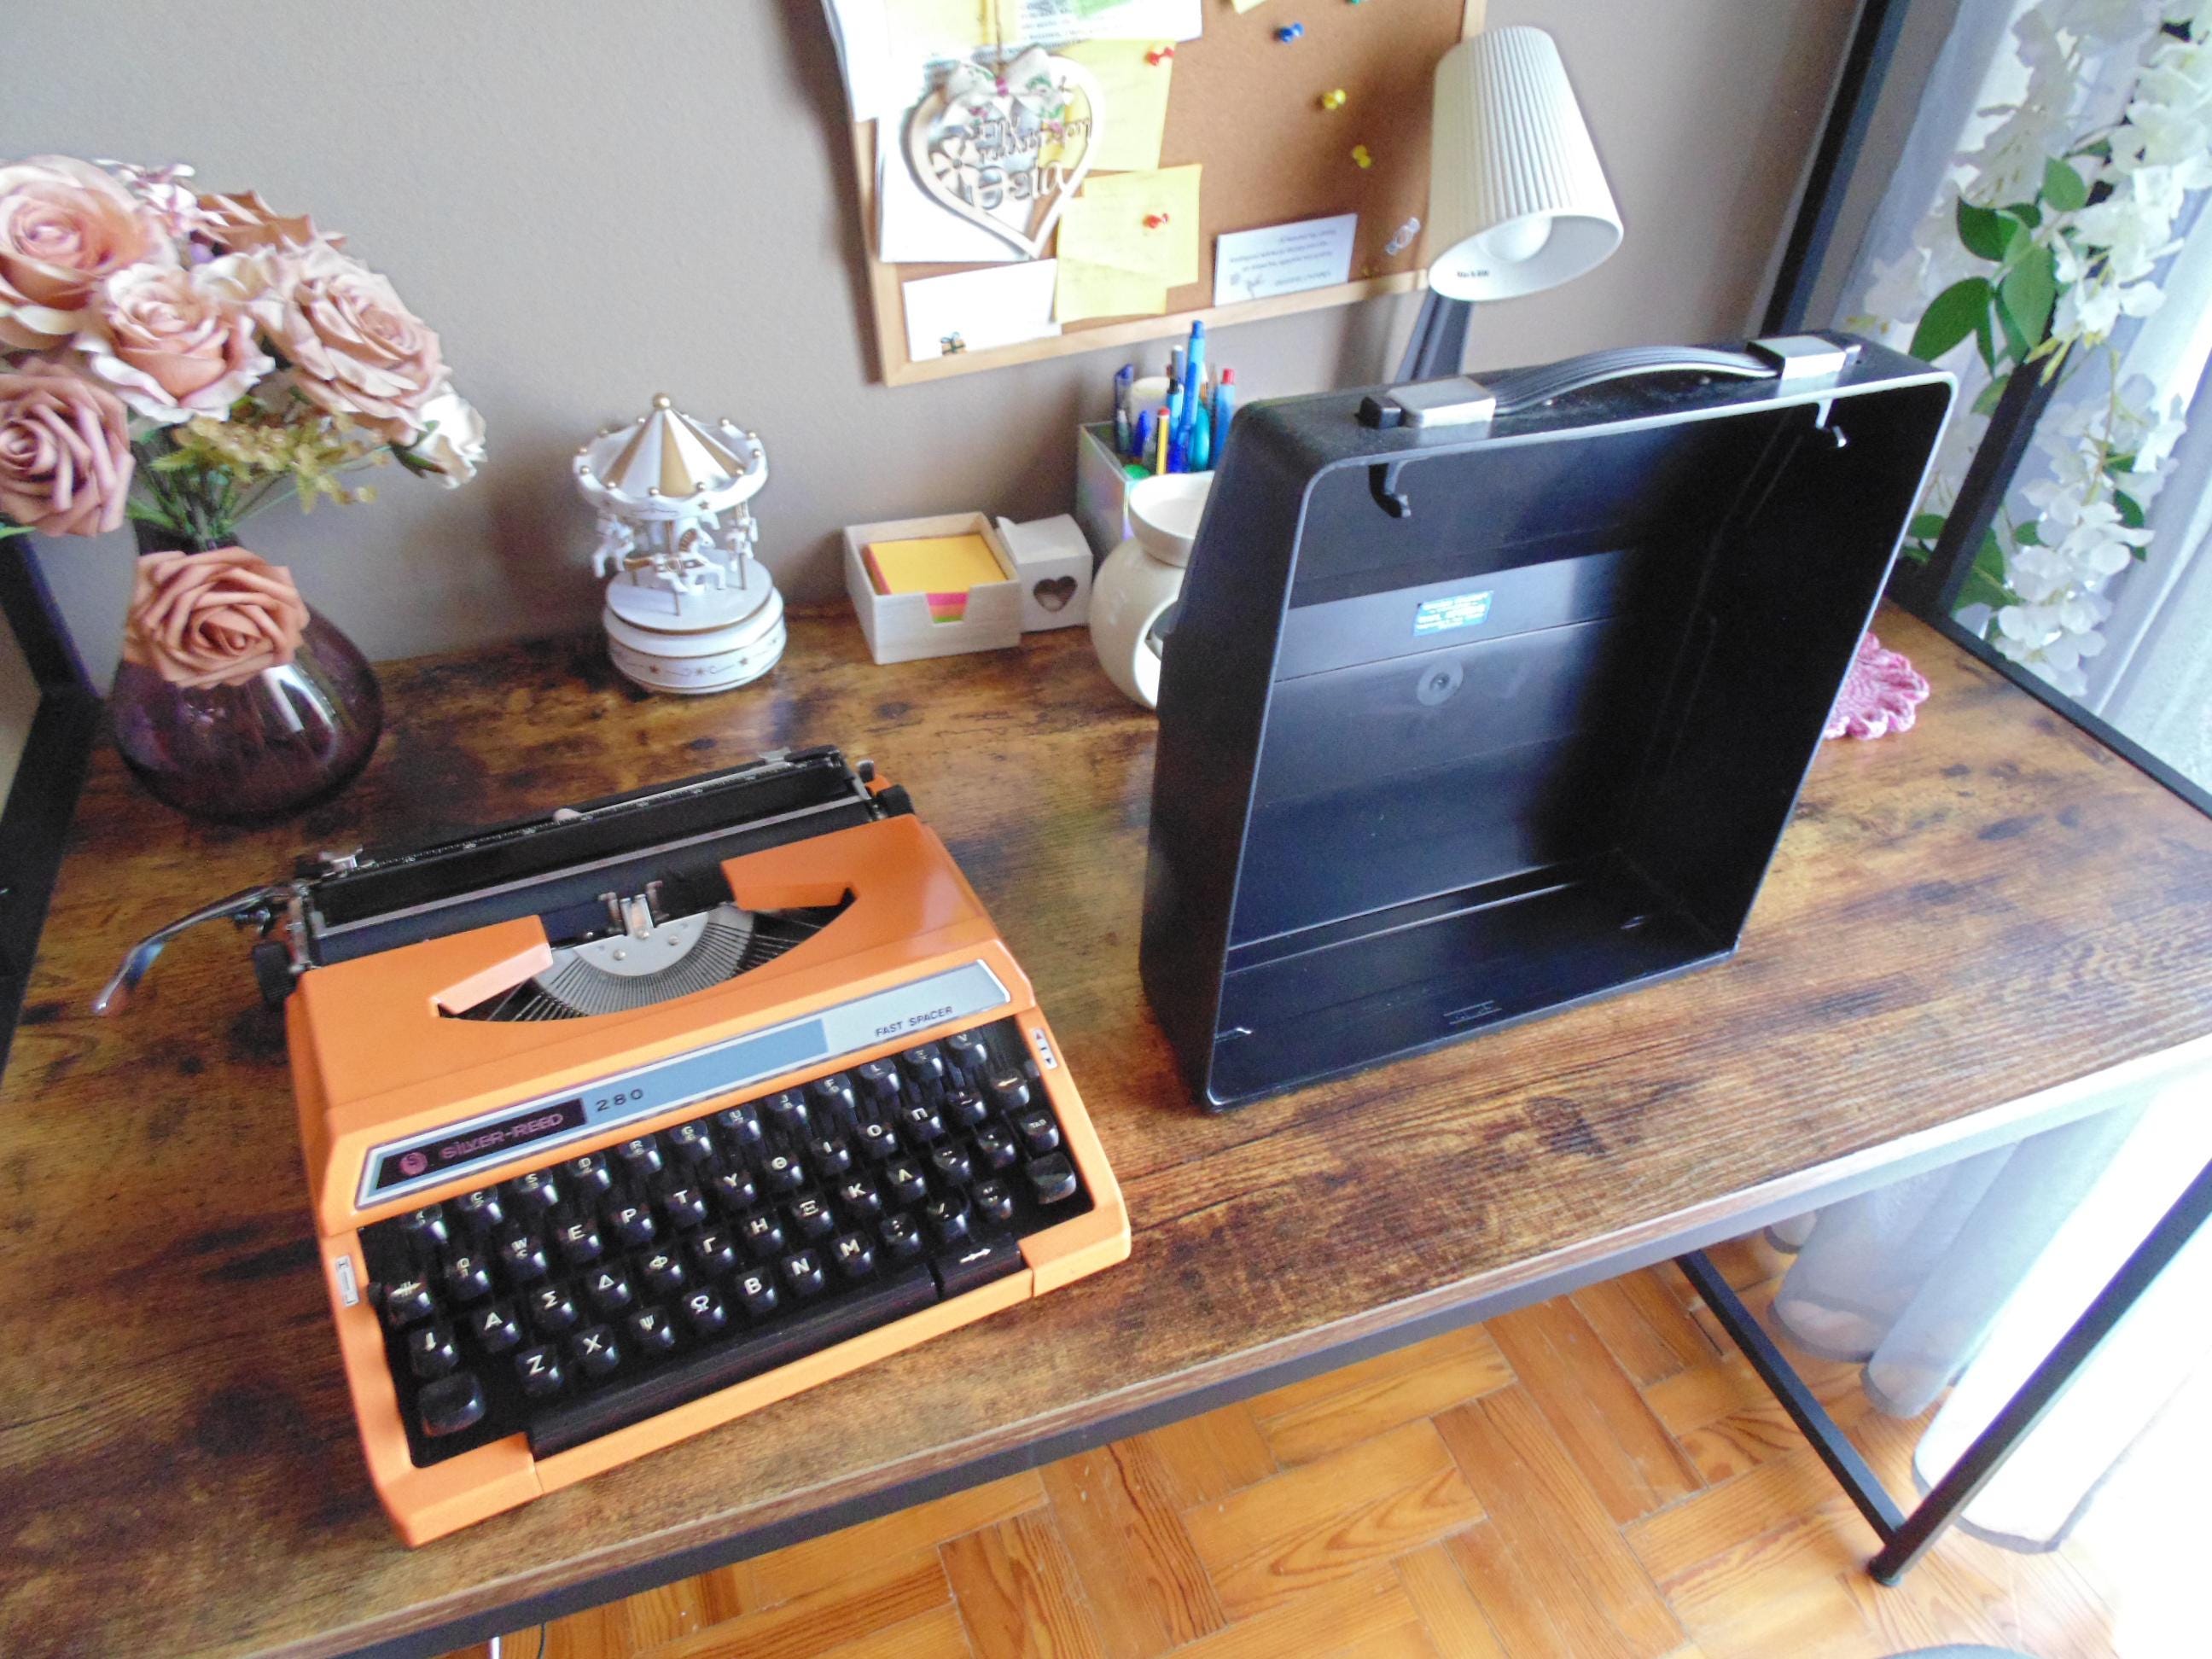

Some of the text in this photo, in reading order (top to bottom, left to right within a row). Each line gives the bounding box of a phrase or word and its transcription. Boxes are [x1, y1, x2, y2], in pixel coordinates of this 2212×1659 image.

[876, 1005, 953, 1037] FAST SPACER
[596, 1088, 644, 1113] 280
